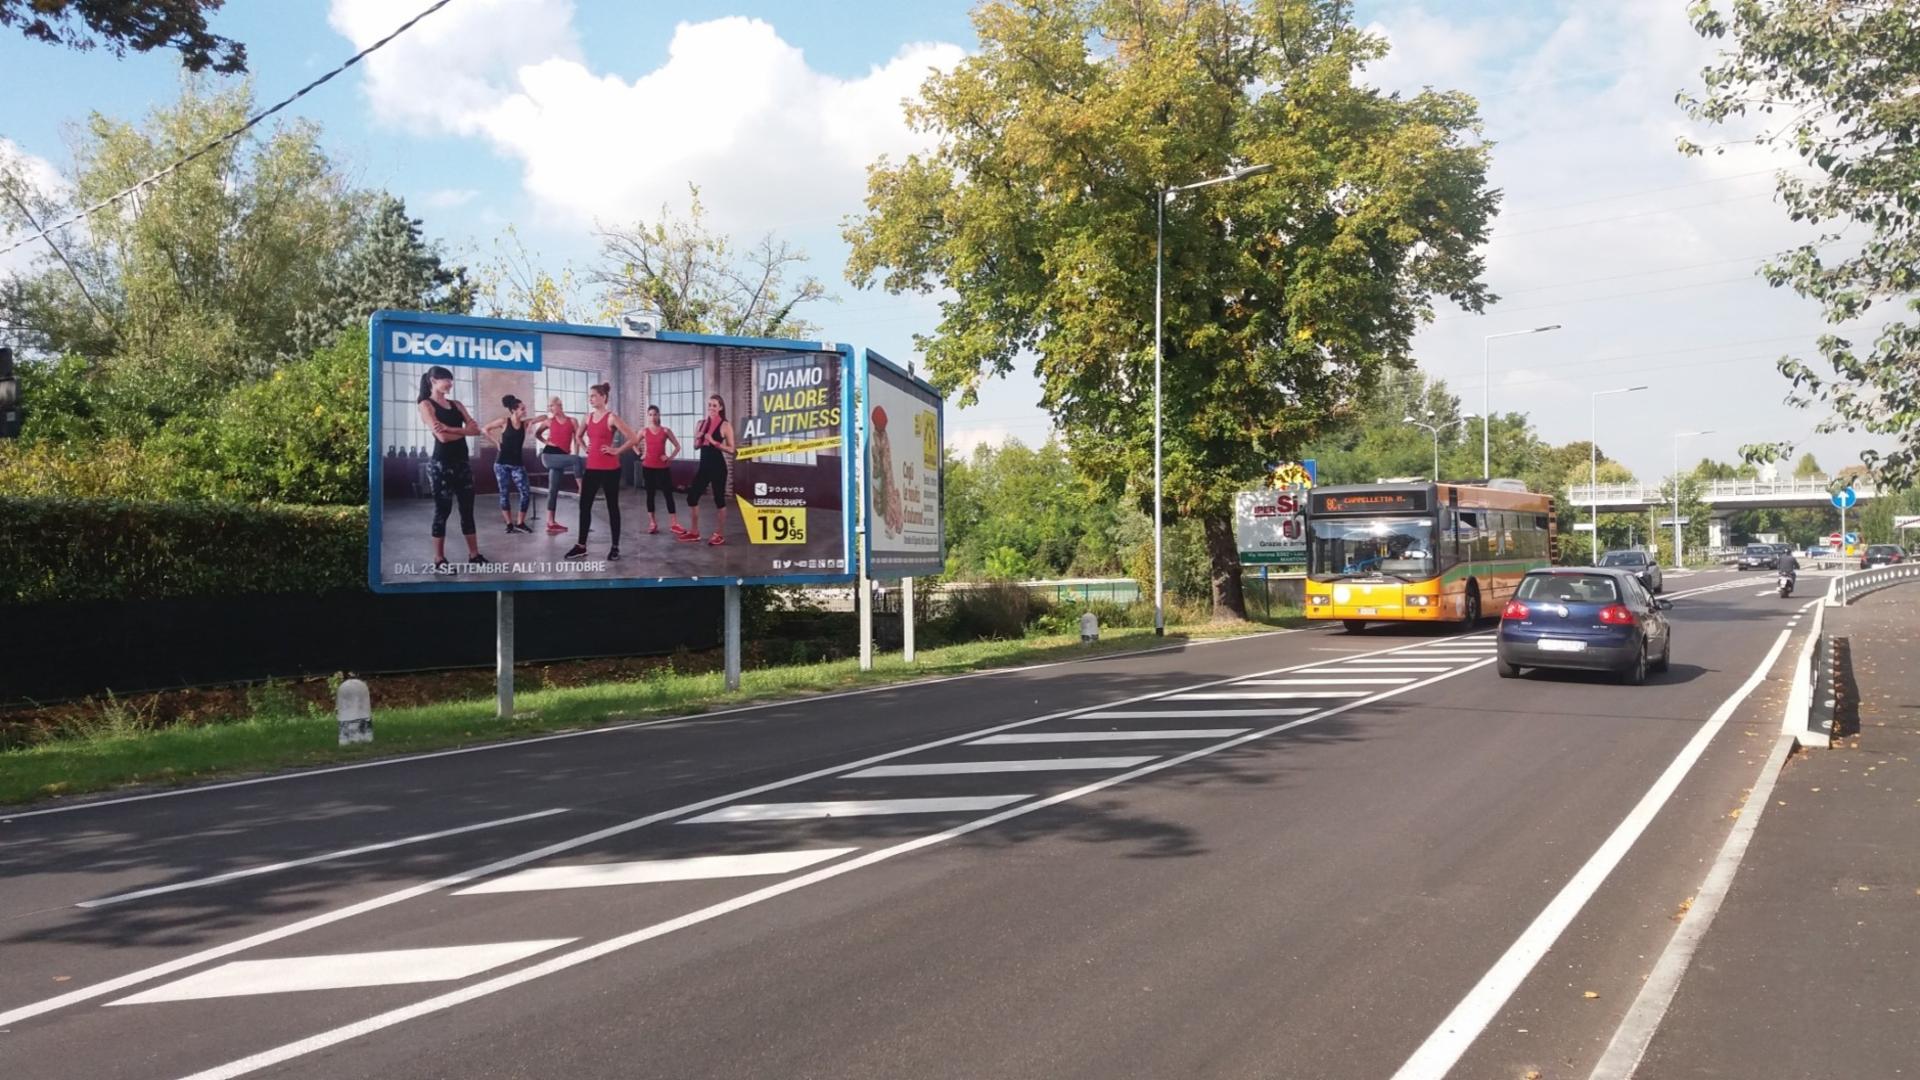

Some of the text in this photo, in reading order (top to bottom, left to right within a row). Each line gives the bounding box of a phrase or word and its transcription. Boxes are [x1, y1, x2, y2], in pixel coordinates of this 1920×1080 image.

[392, 331, 533, 363] DECATHLON
[767, 367, 822, 391] DIAMO
[763, 388, 827, 413] VALORE
[744, 408, 840, 438] AL FITNESS
[753, 498, 783, 506] LEGGINGS
[1254, 505, 1276, 514] IPER
[757, 515, 789, 541] 19
[394, 562, 418, 575] DAL
[421, 562, 437, 575] 23
[438, 561, 509, 574] SETTEMBRE
[555, 560, 606, 573] OTTOBRE
